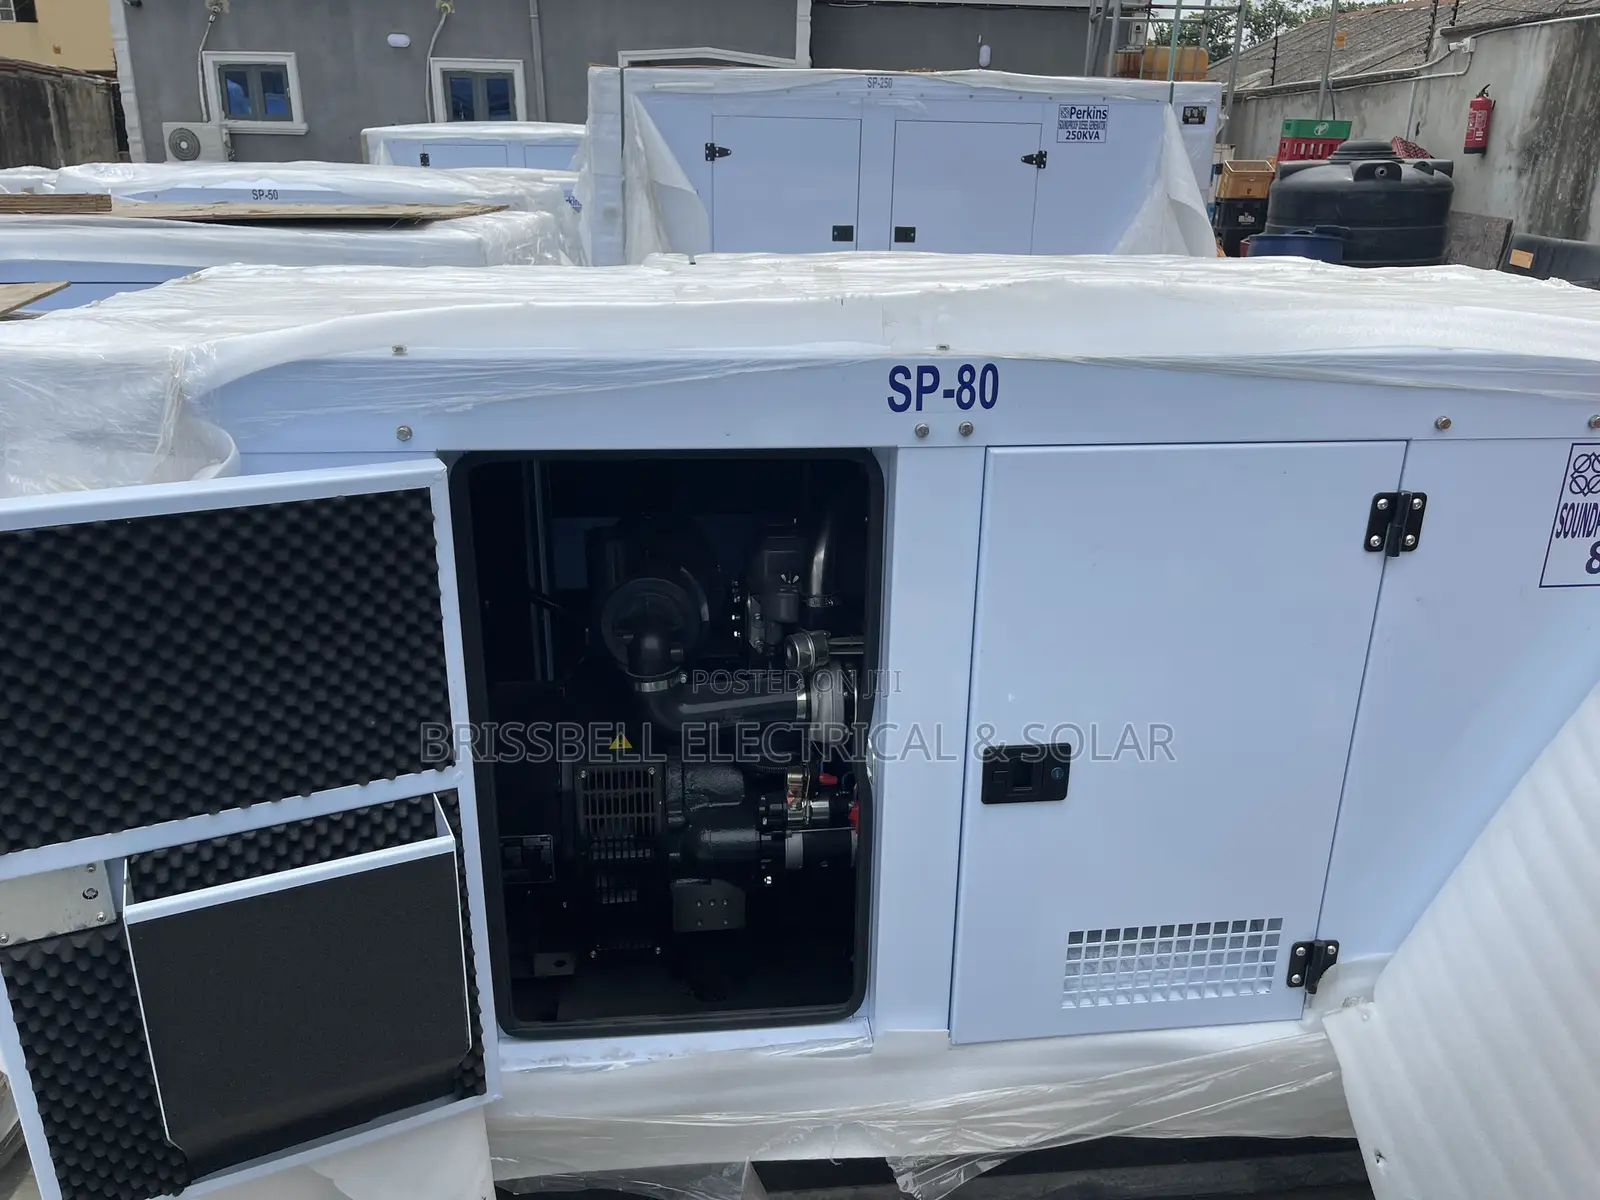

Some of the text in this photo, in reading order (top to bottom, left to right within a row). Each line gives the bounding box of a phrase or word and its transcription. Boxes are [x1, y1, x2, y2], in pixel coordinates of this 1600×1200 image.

[867, 77, 893, 89] SP-250
[1069, 106, 1108, 120] Perkins
[1065, 130, 1100, 140] 250KVA
[251, 189, 279, 200] SP-50
[887, 363, 999, 413] SP-80
